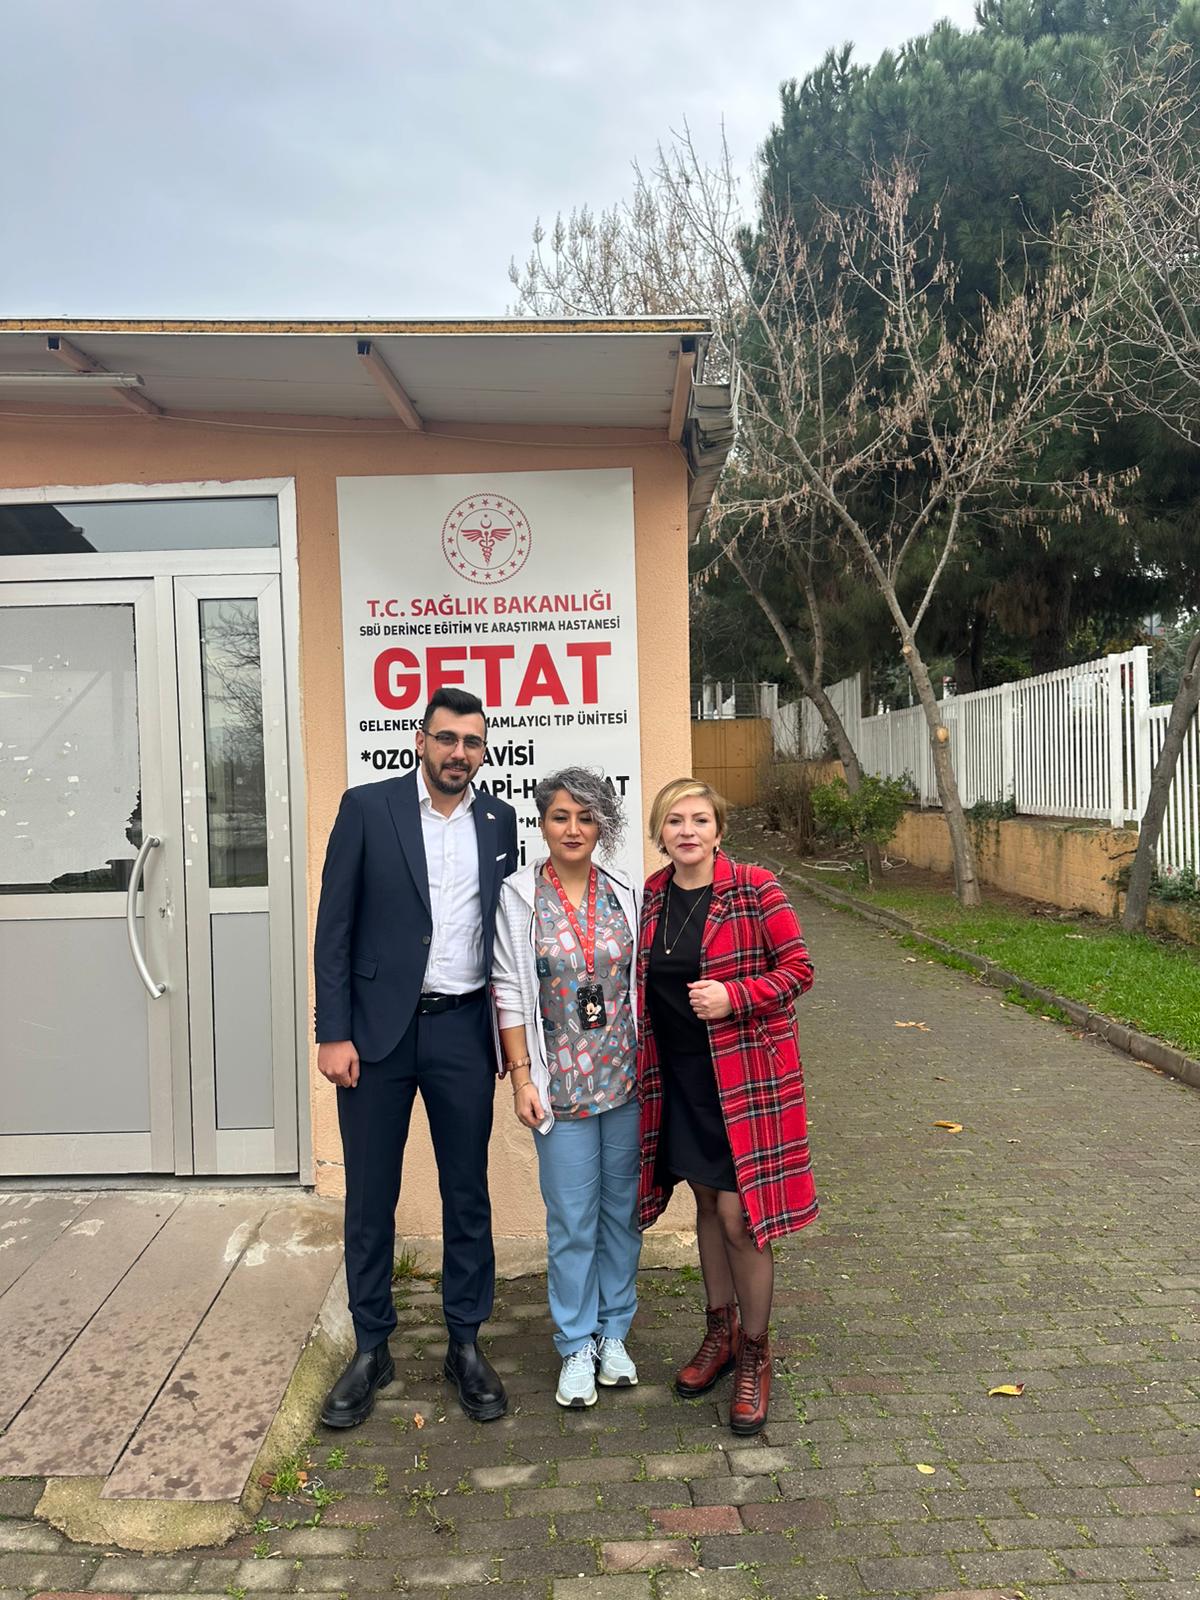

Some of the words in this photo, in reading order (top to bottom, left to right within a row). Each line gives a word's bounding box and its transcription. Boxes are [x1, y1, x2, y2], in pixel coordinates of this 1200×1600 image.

[366, 599, 405, 617] T.C.
[410, 594, 488, 616] SAĞLIK
[493, 589, 612, 614] BAKANLIĞI
[360, 622, 381, 636] SBÜ
[384, 622, 431, 635] DERİNCE
[434, 620, 472, 634] EĞİTİM
[474, 623, 488, 633] VE
[491, 620, 556, 633] ARAŞTIRMA
[558, 616, 620, 630] HASTANESİ
[373, 642, 612, 710] GETAT
[359, 719, 424, 732] GELENEKS
[554, 714, 574, 726] TIP
[577, 710, 627, 725] ÜNİTESİ
